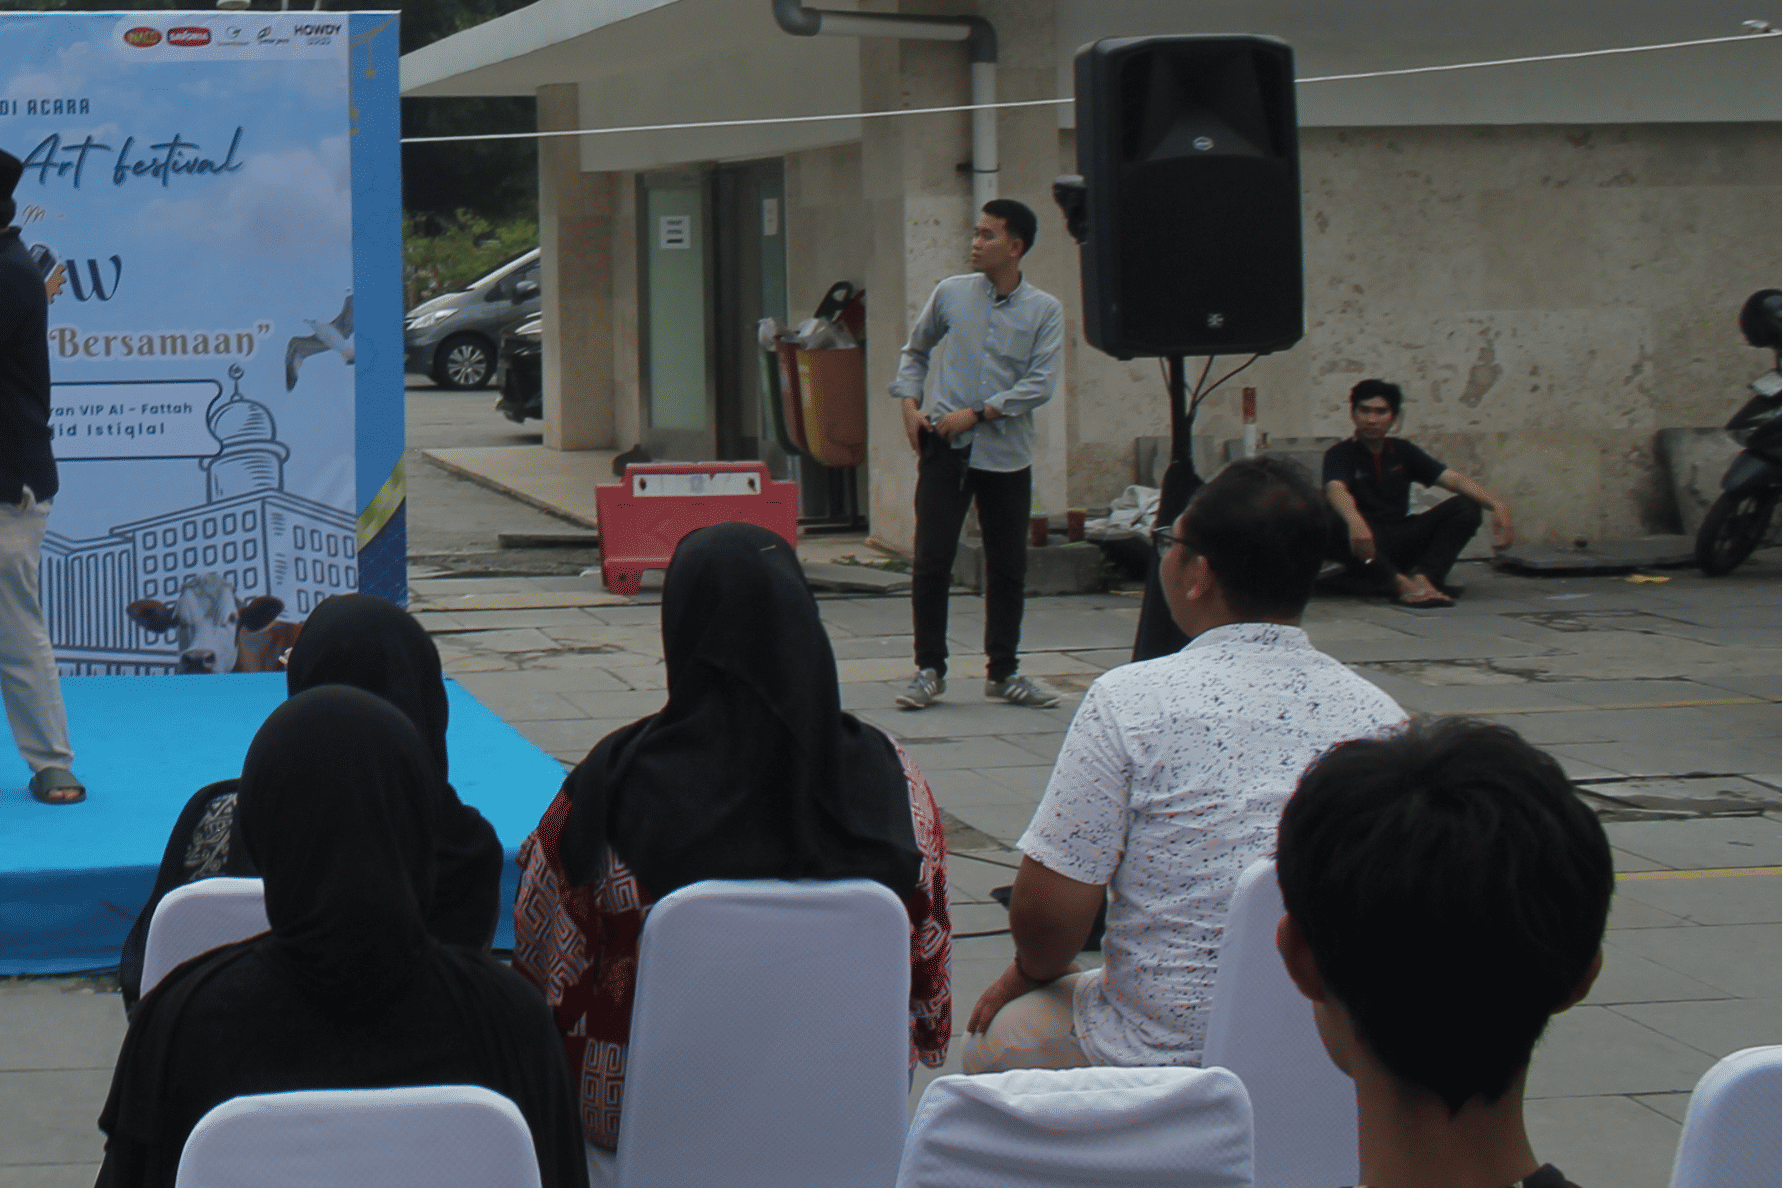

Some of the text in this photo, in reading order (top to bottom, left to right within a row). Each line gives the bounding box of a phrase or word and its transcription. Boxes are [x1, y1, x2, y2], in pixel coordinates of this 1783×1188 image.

[293, 24, 342, 36] HOWDY
[0, 99, 17, 116] DI
[27, 98, 90, 116] ACARA
[23, 132, 113, 190] Art
[79, 404, 104, 417] VIP
[141, 402, 193, 416] Fattah
[86, 422, 165, 440] Istiqlal
